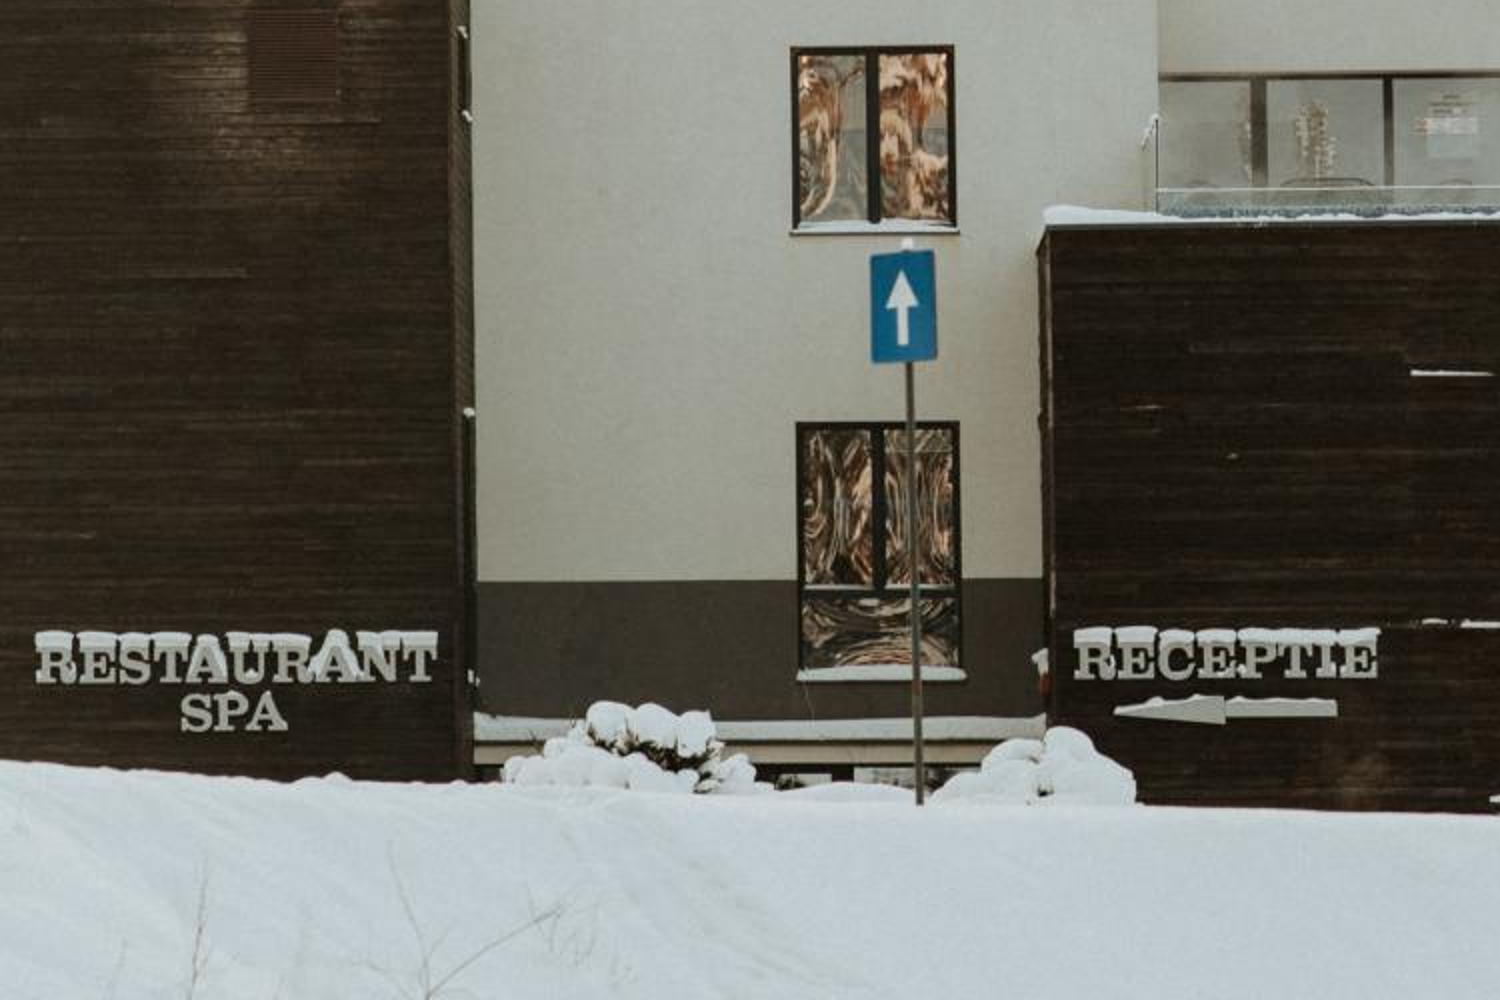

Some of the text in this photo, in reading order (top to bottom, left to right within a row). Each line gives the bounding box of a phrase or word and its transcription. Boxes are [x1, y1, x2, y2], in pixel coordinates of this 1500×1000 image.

[35, 631, 438, 684] RESTAURANT
[1073, 629, 1379, 680] RECEPTIE
[181, 693, 289, 732] SPA
